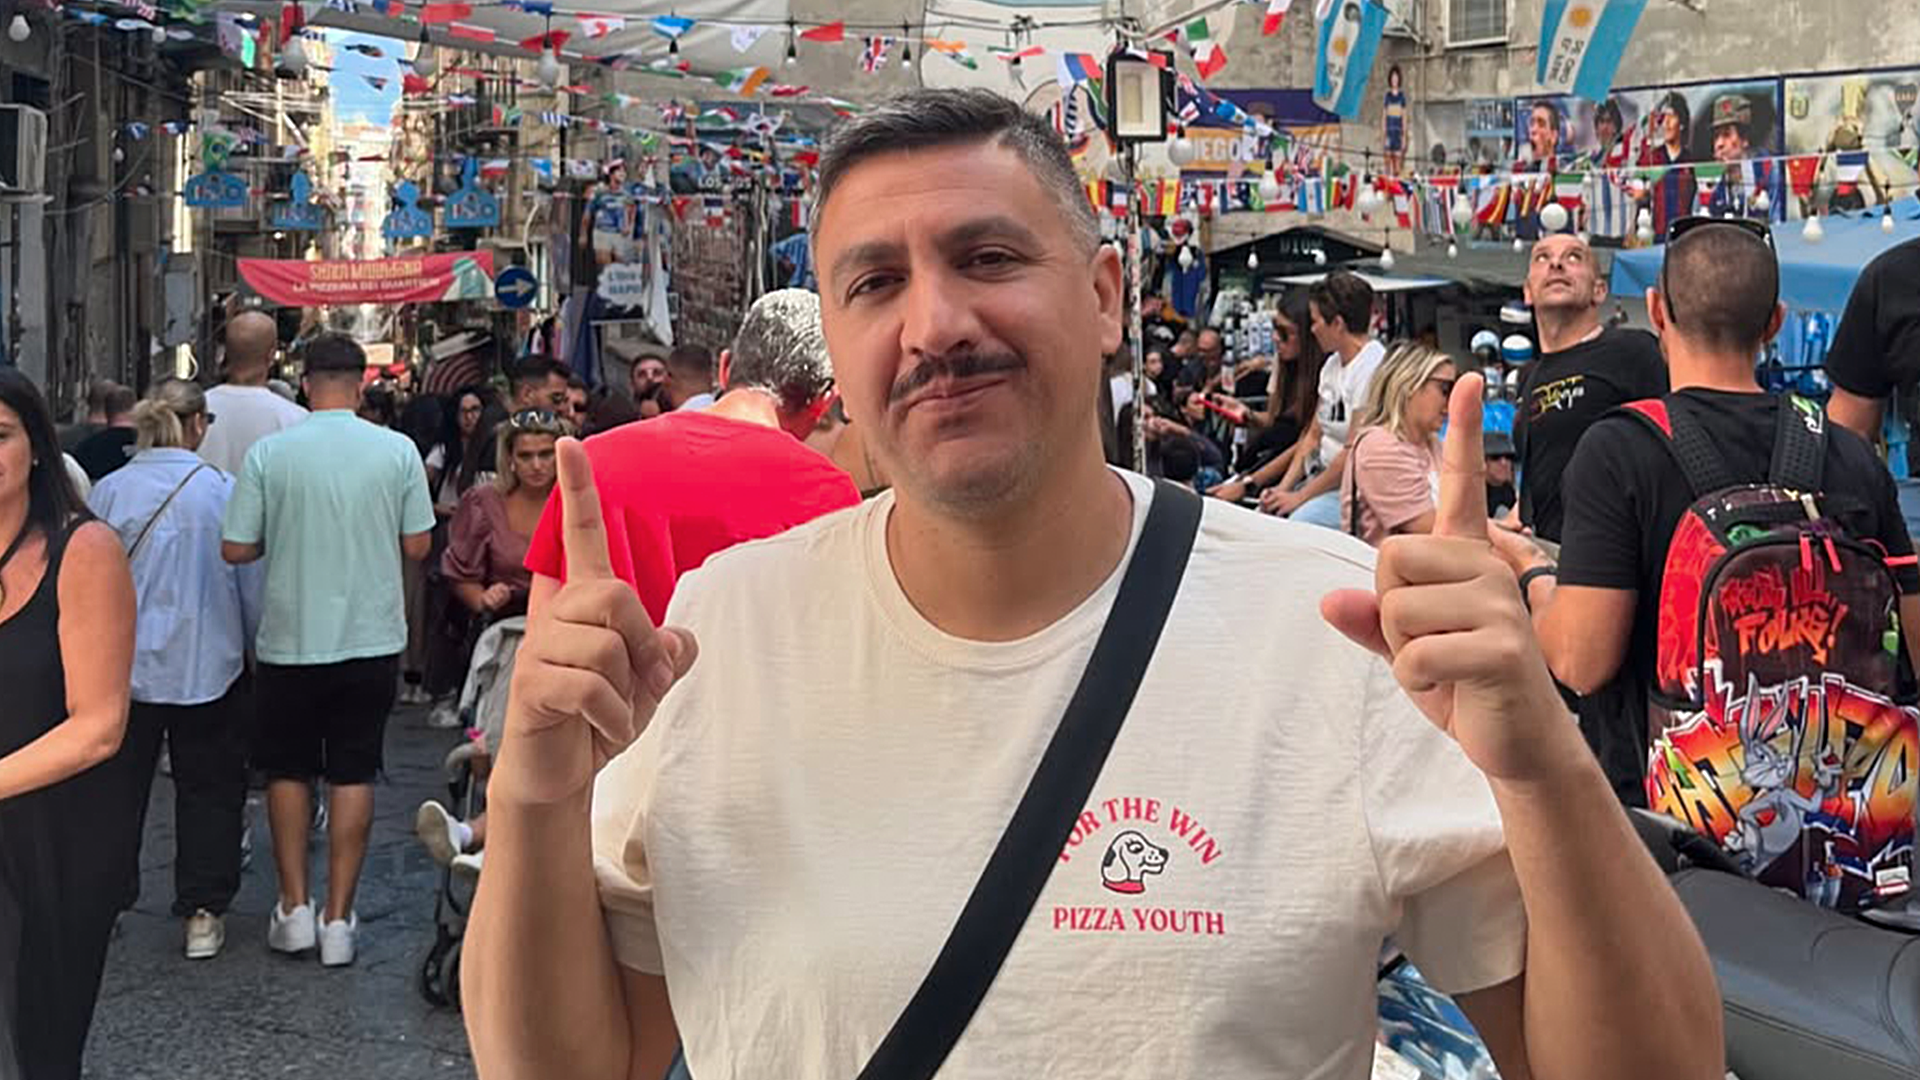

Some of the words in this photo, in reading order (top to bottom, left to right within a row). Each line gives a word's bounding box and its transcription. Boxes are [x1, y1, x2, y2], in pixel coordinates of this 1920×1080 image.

[1103, 797, 1161, 824] THE
[1170, 807, 1222, 865] WIN
[1053, 907, 1126, 931] PIZZA
[1132, 908, 1225, 935] YOUTH
